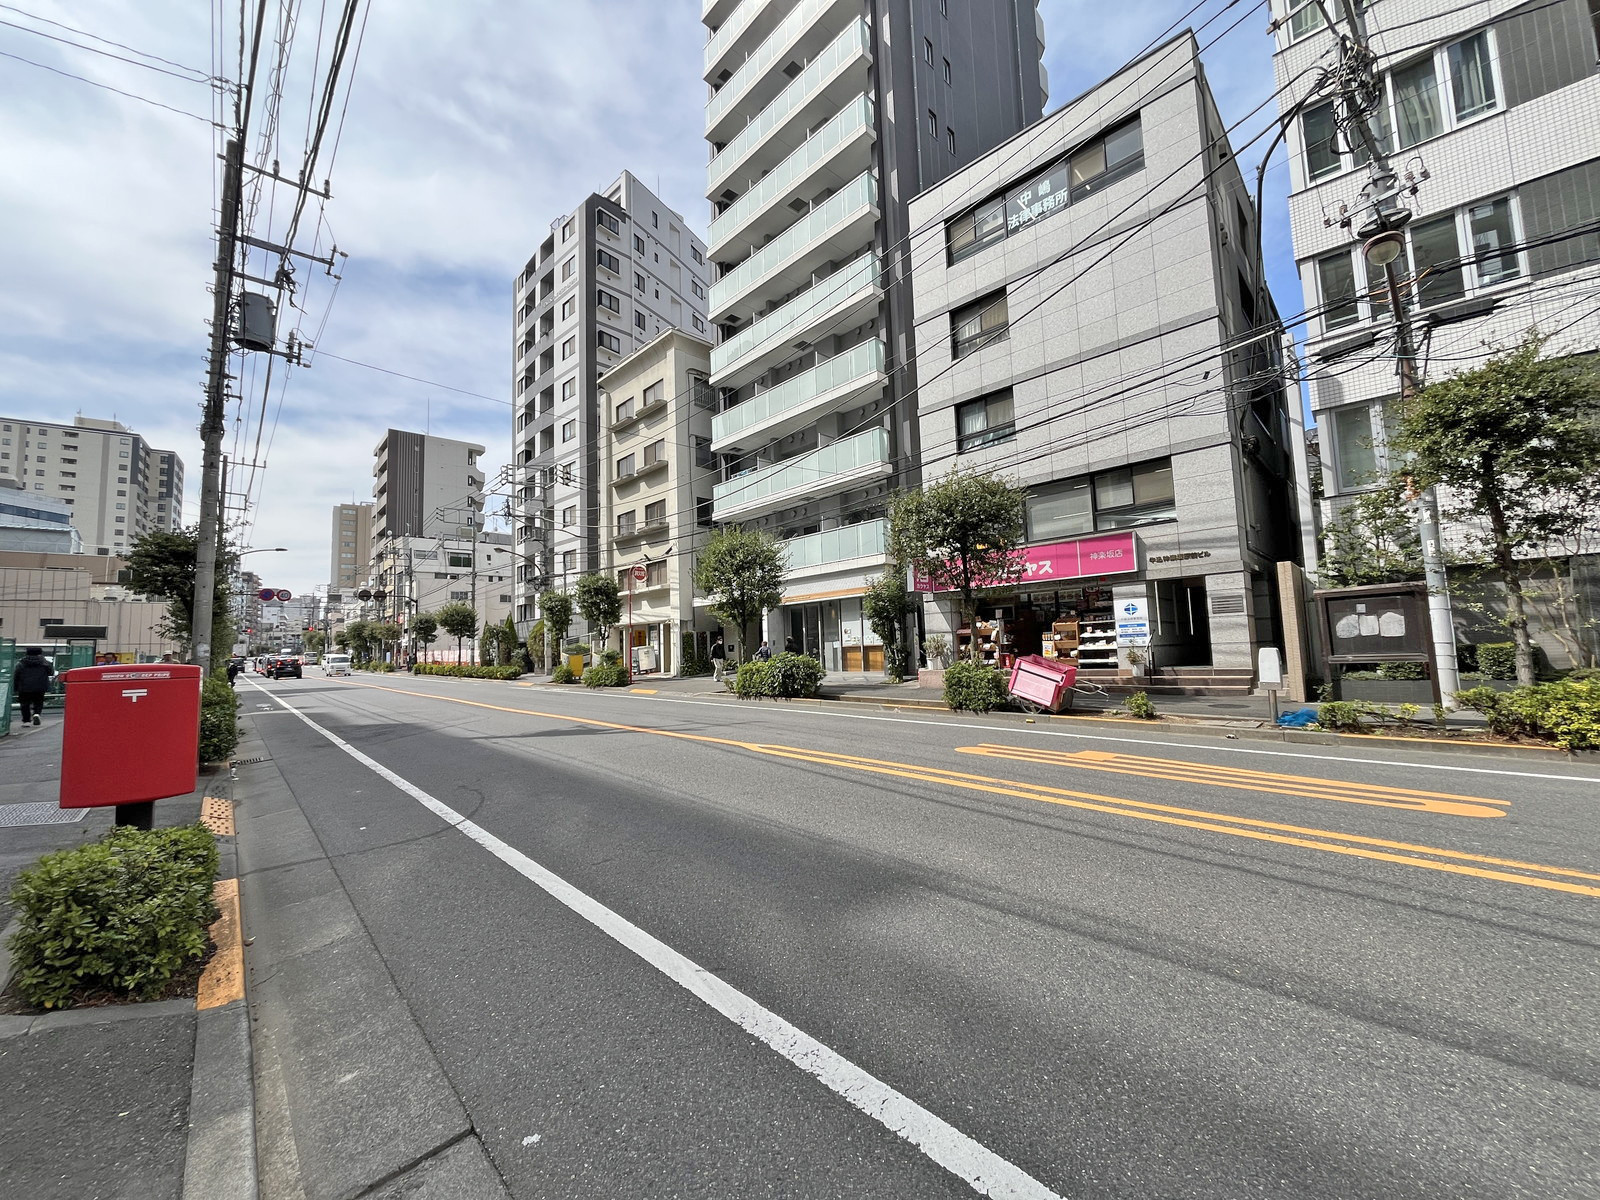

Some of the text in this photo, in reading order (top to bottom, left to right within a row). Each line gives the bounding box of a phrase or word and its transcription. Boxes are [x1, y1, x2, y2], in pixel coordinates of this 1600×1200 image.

[1008, 188, 1068, 230] 法律事務所
[1089, 548, 1123, 560] 神楽坂店
